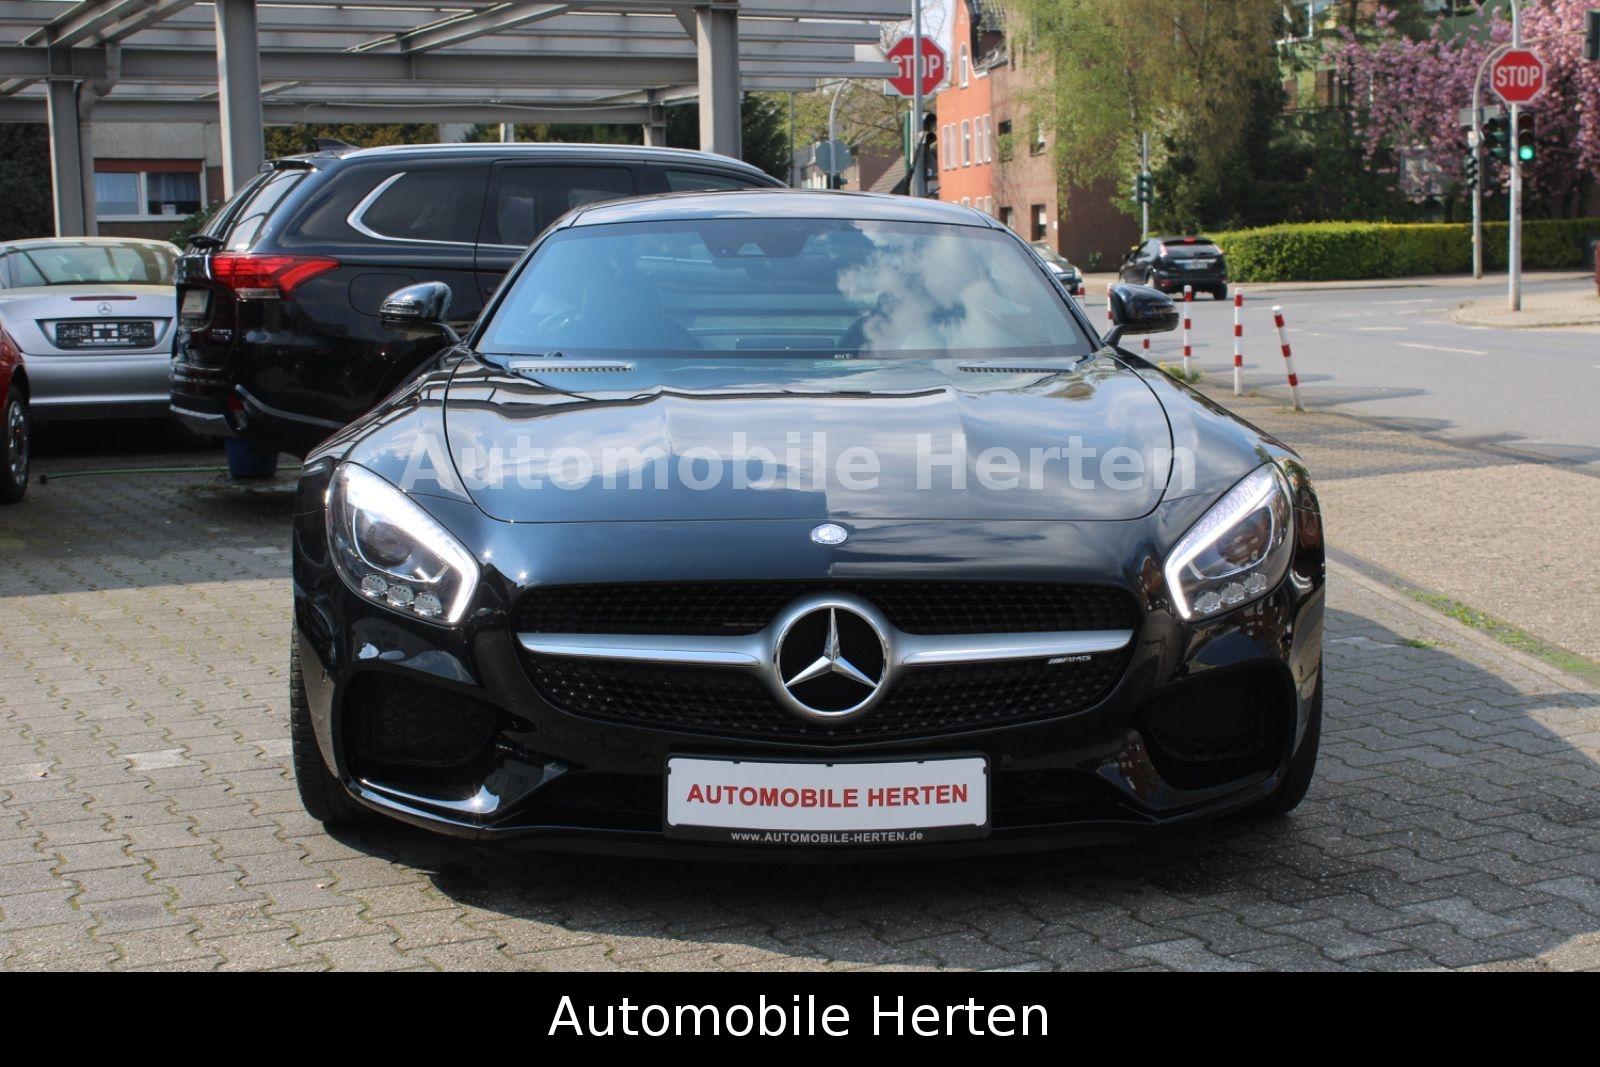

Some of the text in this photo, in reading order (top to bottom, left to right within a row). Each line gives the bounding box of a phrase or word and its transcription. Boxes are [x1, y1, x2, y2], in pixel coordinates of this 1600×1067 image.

[1496, 65, 1540, 87] STOP
[686, 783, 969, 809] AUTOMOBILE HERTEN
[730, 830, 924, 844] www.AUTOMOBILE-HERTEN.de
